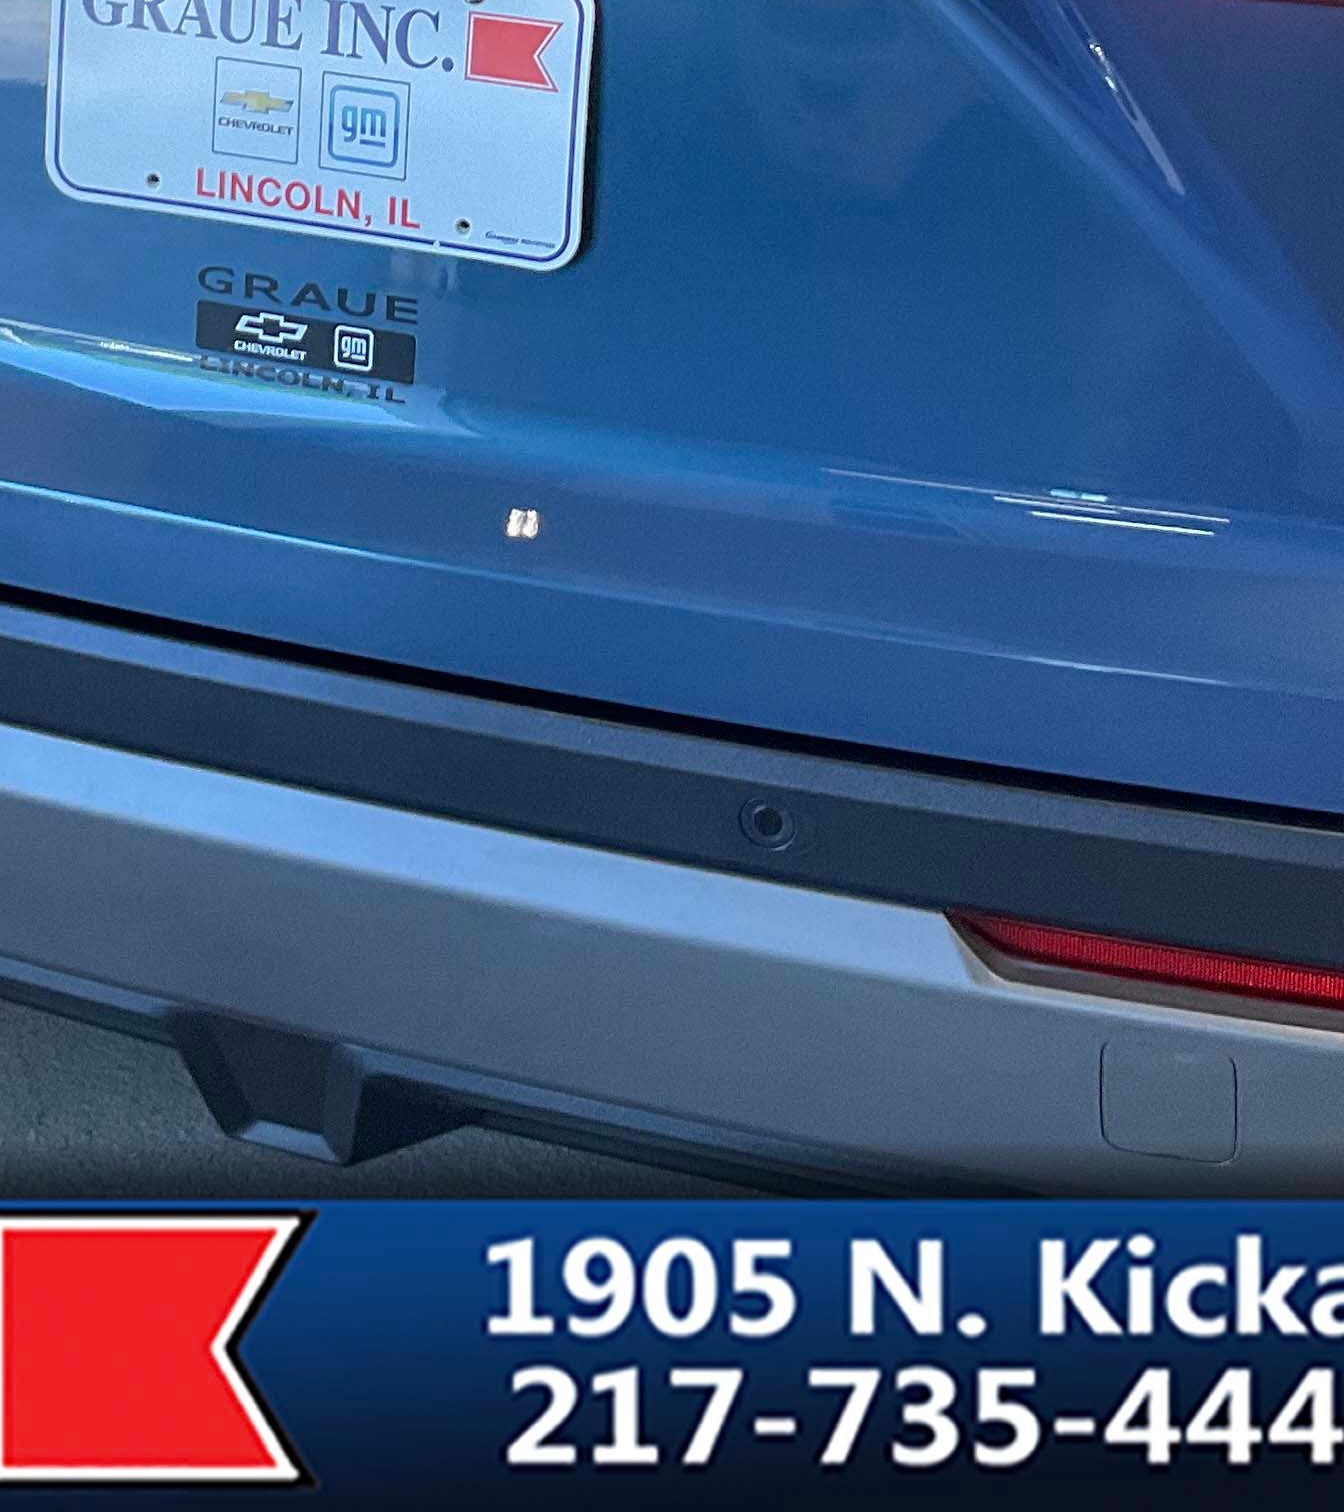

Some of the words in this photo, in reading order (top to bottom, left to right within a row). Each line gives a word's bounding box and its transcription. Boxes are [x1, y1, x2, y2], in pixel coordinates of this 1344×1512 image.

[217, 115, 295, 136] CHEVROLET
[196, 167, 373, 227] LINCOLN,
[388, 196, 421, 229] IL
[198, 266, 418, 325] GRAUE
[233, 339, 307, 361] CHEVROLET
[341, 335, 367, 361] gm
[367, 384, 405, 404] IL
